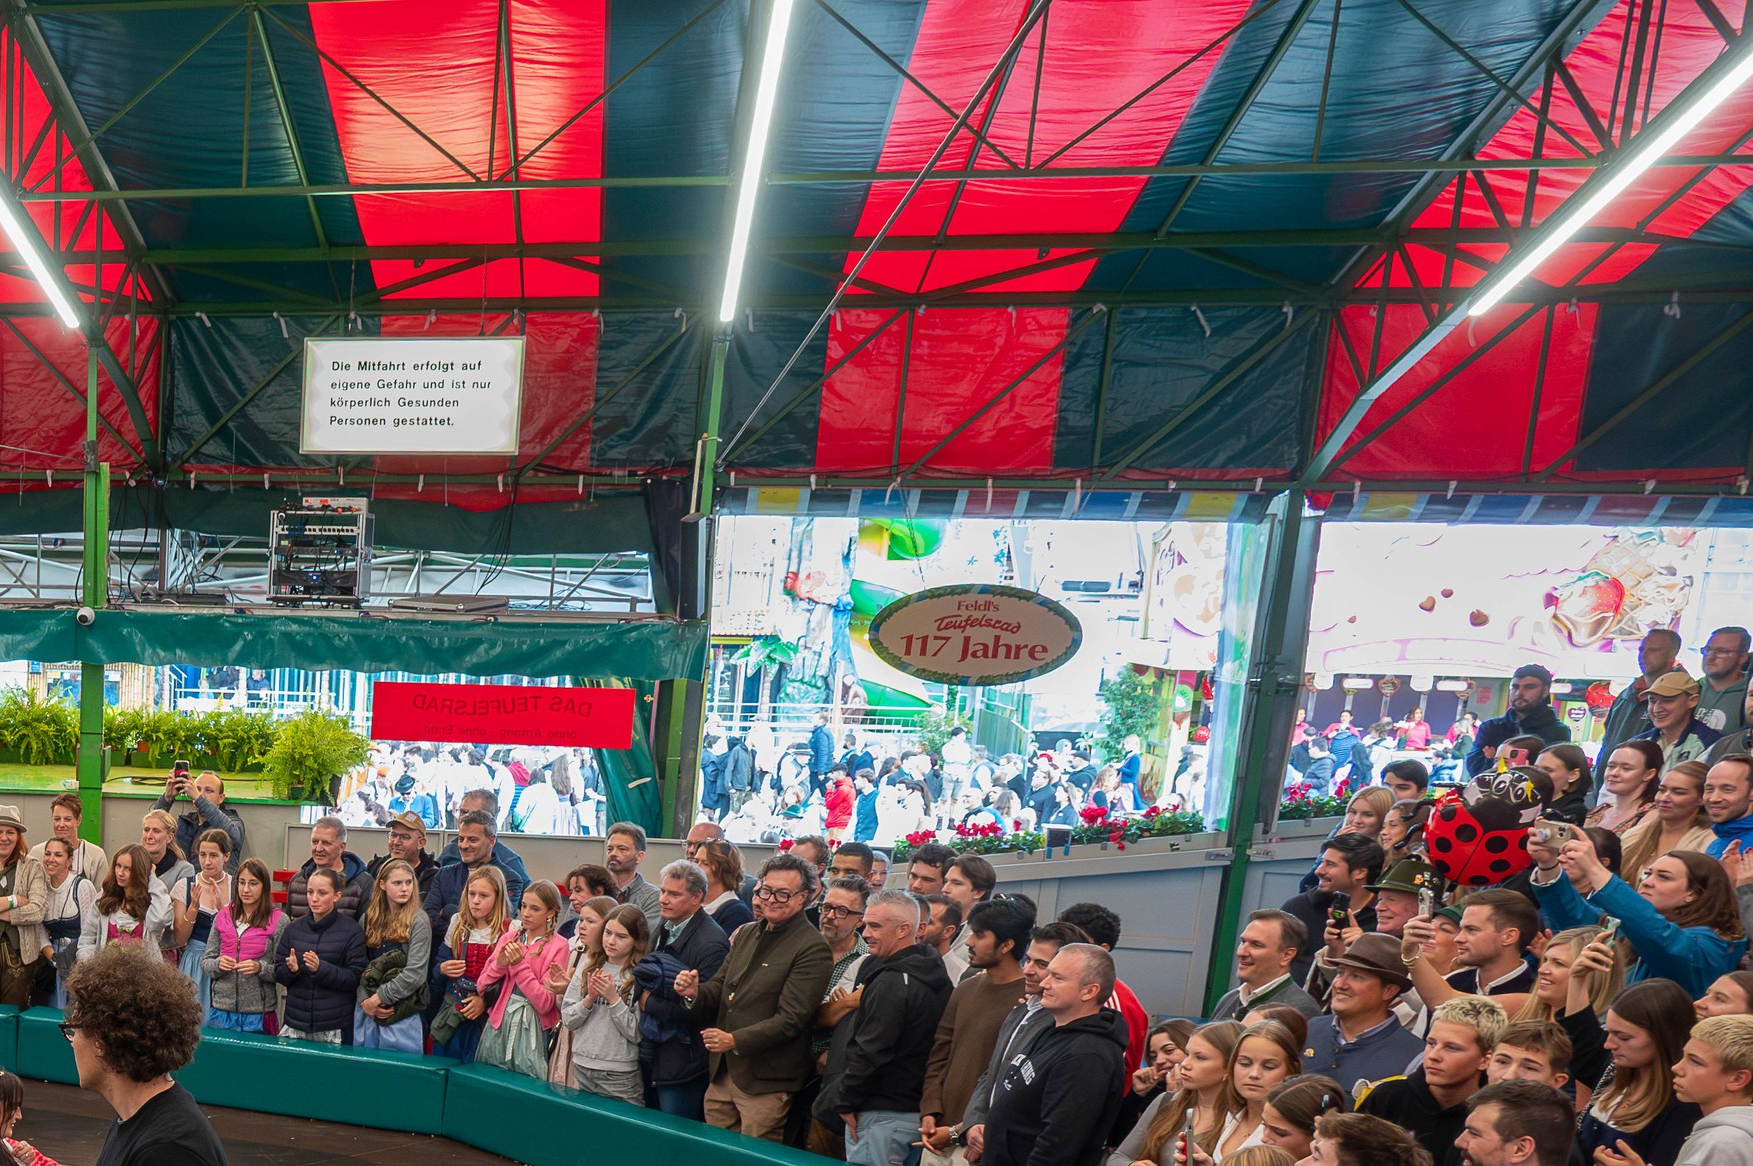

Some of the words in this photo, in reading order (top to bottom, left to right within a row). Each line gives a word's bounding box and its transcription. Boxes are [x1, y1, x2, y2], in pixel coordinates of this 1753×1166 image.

[331, 361, 351, 371] Die
[357, 361, 406, 371] Mitfahrt
[413, 361, 455, 373] erfolgt
[461, 360, 482, 371] auf
[330, 379, 371, 391] eigene
[376, 379, 417, 389] Gefahr
[423, 379, 445, 389] und
[451, 379, 466, 389] ist
[472, 381, 492, 389] nur
[330, 397, 391, 409] körperlich
[397, 397, 459, 408] Gesunden
[329, 415, 387, 426] Personen
[393, 416, 455, 428] gestattet.
[956, 600, 1000, 612] Feldl's
[933, 614, 1022, 635] Teufelsrad
[900, 633, 952, 657] 117
[956, 635, 1049, 663] Jahre
